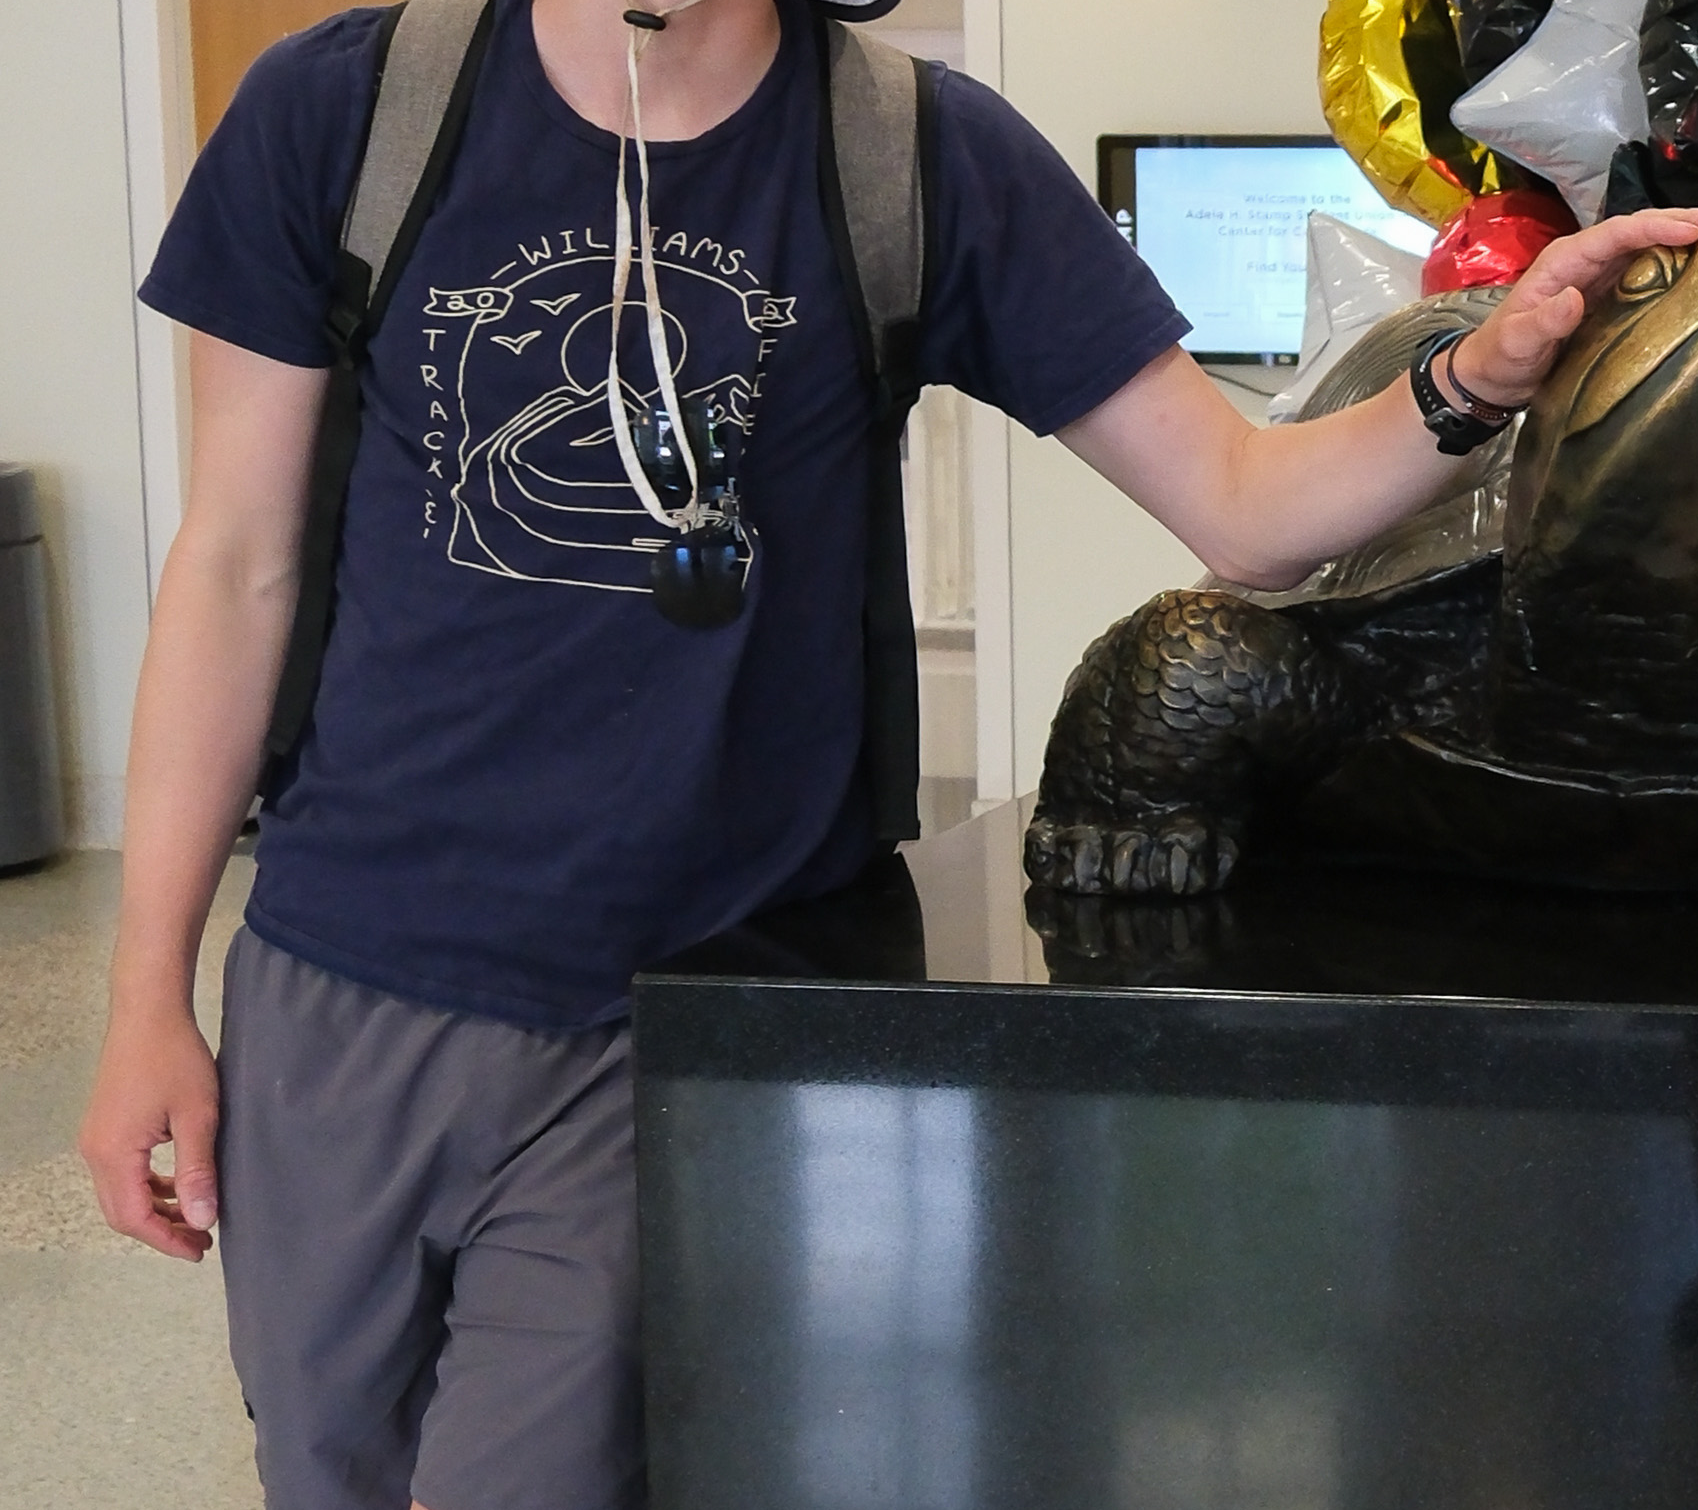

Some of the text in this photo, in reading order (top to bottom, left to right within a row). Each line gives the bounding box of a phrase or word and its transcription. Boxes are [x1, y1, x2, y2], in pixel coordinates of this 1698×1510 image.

[1311, 194, 1325, 205] to
[1330, 194, 1351, 205] the
[1267, 226, 1289, 237] for
[519, 226, 747, 276] WILIAMS
[1247, 262, 1277, 273] Find
[419, 328, 450, 479] TRACK
